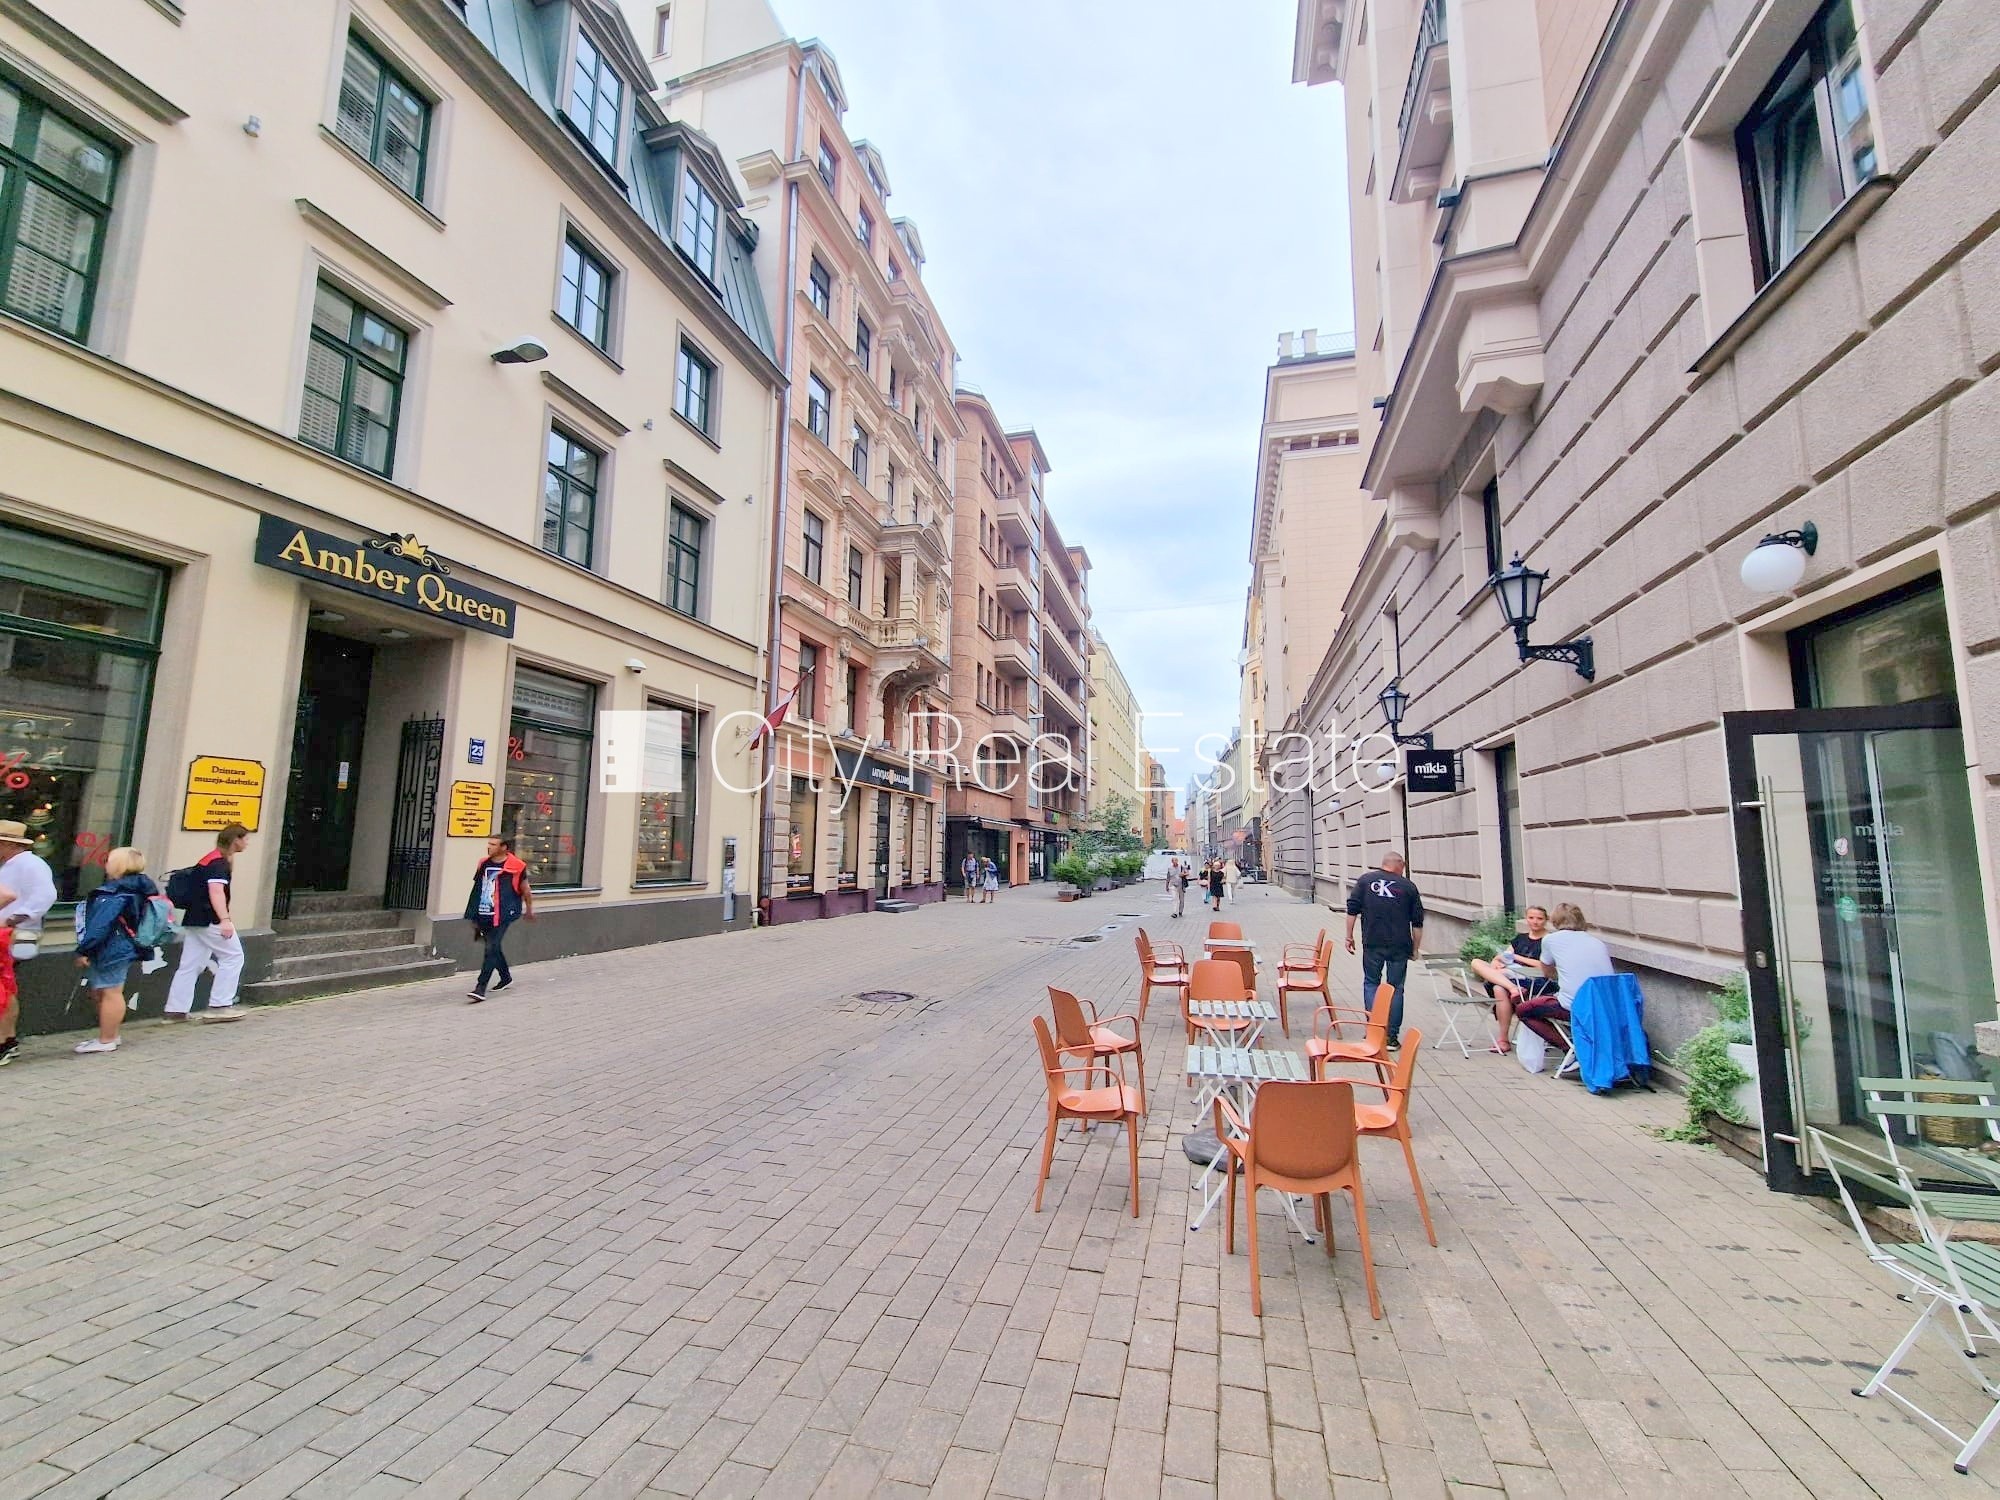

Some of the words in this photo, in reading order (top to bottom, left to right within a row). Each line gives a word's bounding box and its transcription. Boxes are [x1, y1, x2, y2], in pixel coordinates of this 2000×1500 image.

[277, 530, 411, 594] Amber
[416, 573, 507, 628] Queen
[471, 744, 484, 757] 23
[1414, 762, 1448, 774] mīkla
[210, 798, 240, 807] Amber
[206, 809, 241, 817] museum
